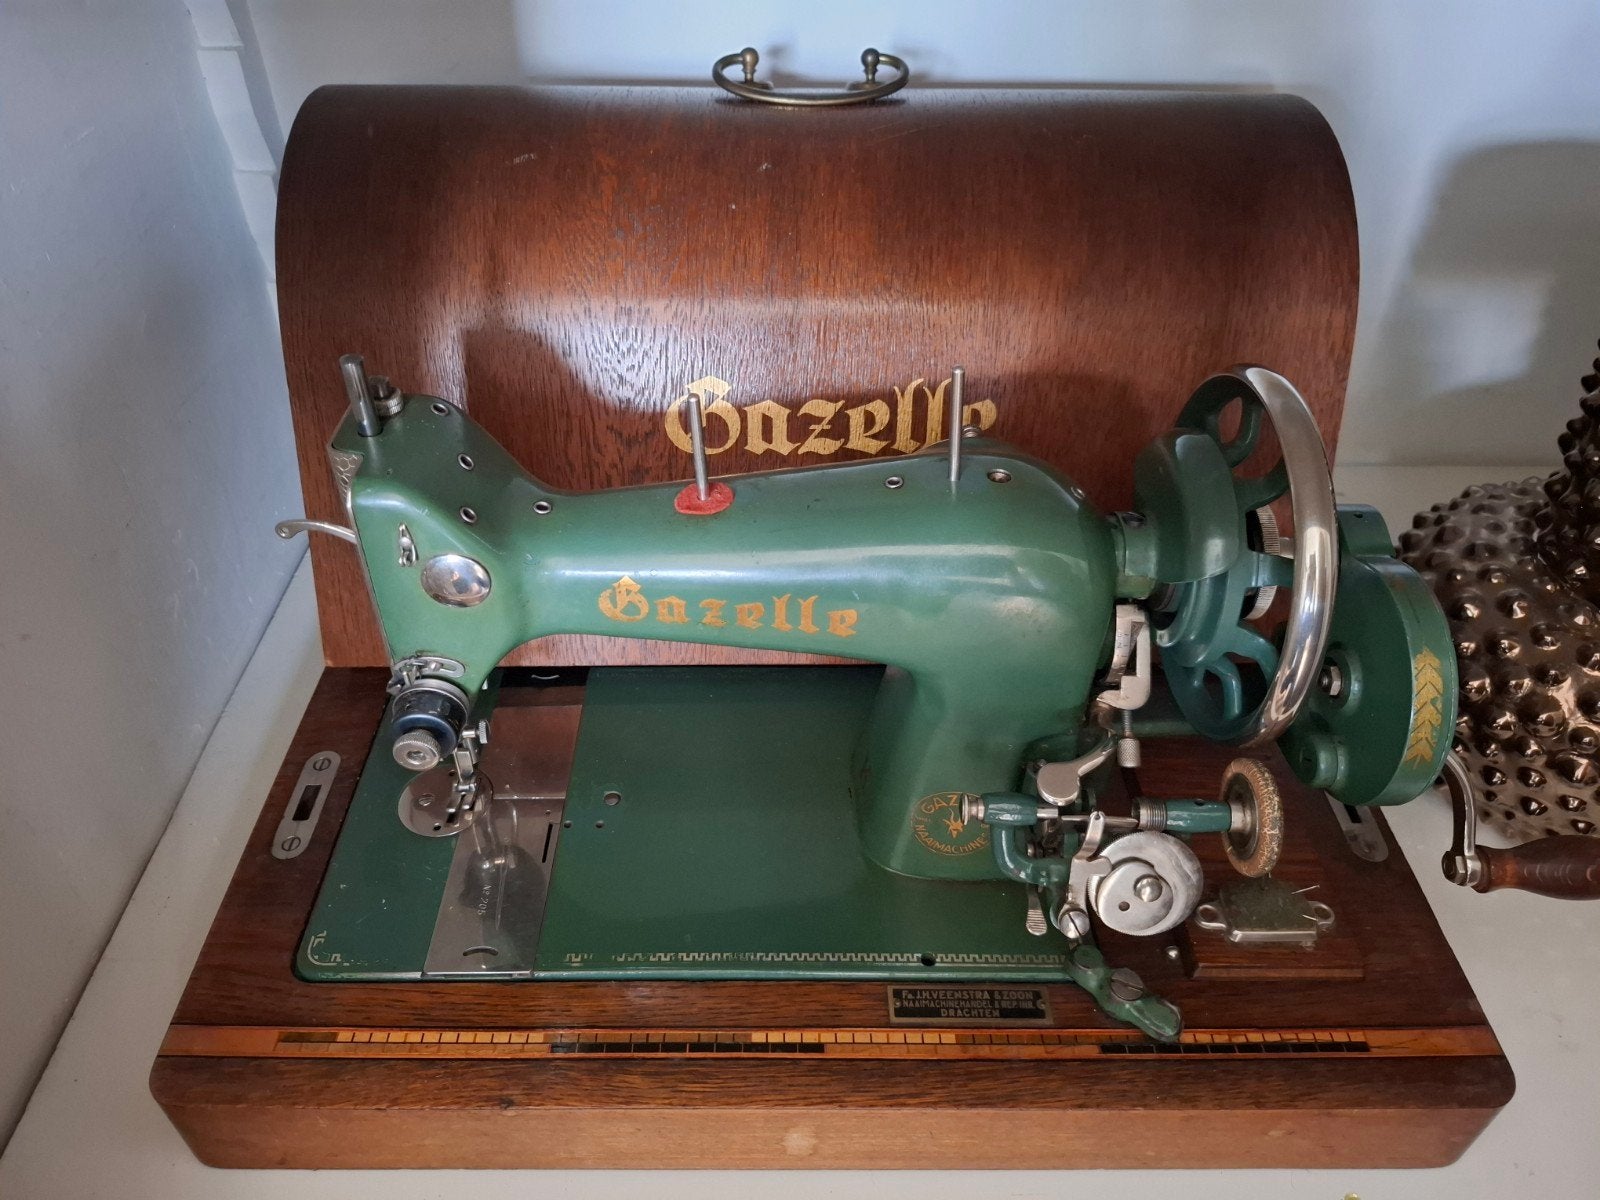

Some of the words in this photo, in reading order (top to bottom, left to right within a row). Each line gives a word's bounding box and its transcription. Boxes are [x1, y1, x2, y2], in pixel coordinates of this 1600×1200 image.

[598, 575, 859, 638] Gazelle
[921, 794, 958, 814] GAZ
[1003, 991, 1034, 1000] ZOON
[940, 1009, 1000, 1018] DRACHTEN
